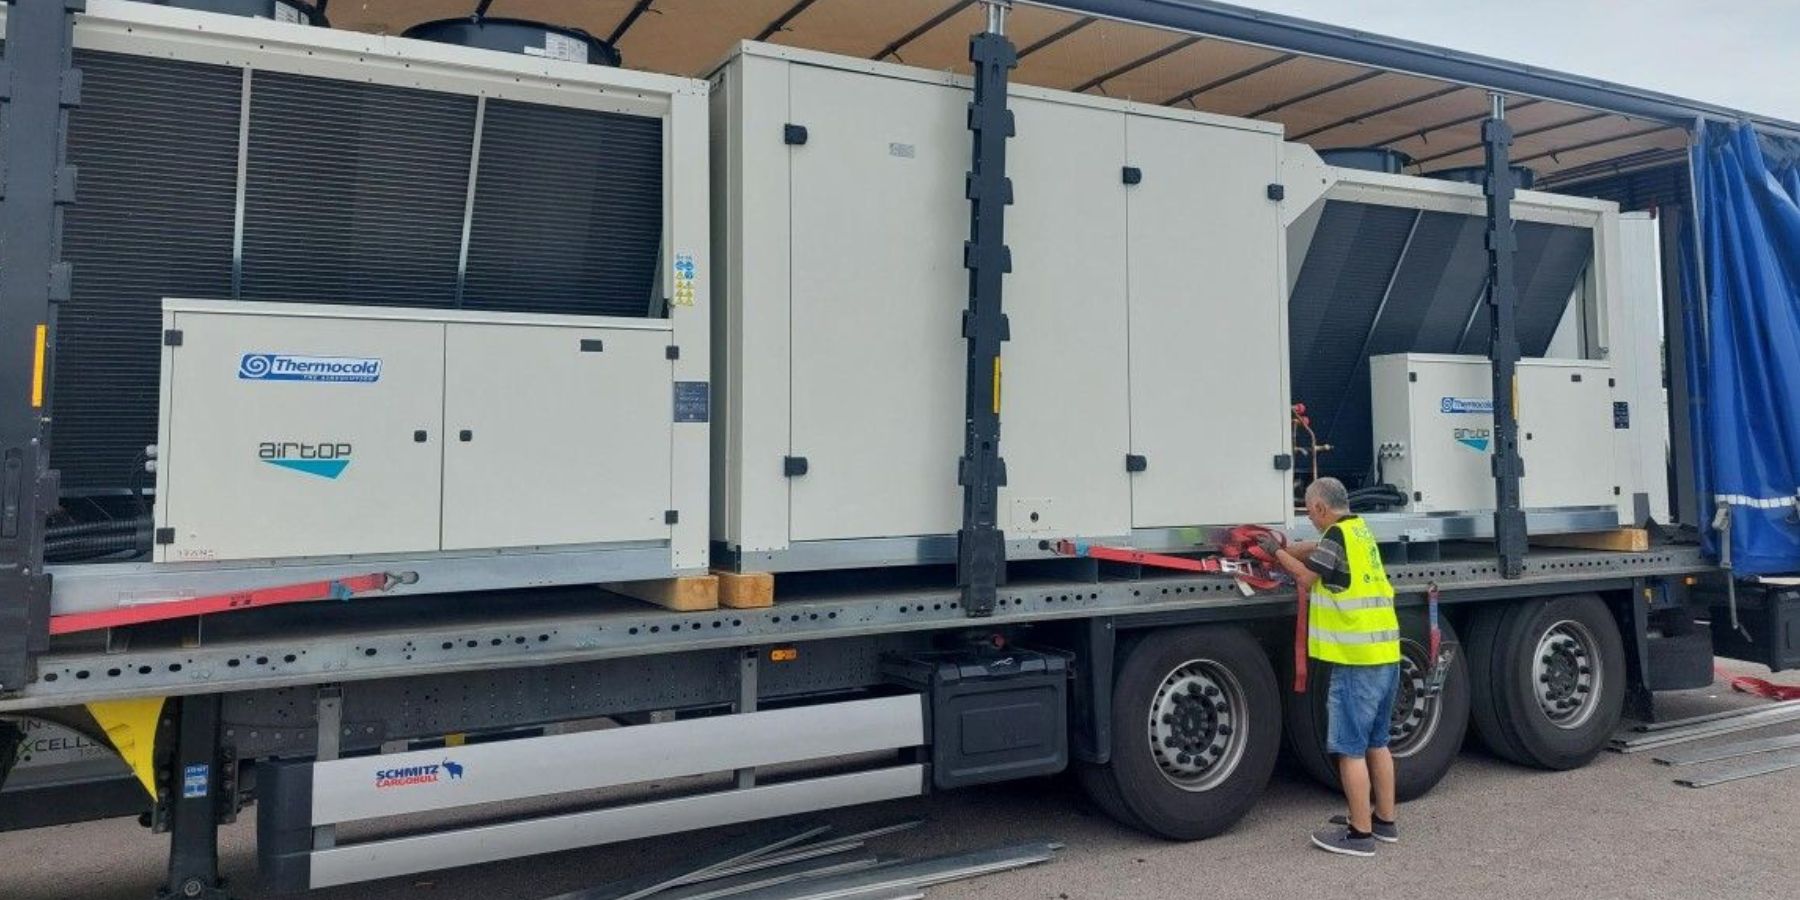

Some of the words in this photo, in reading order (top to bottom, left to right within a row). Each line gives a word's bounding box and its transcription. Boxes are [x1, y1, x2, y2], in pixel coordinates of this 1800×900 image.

[275, 358, 378, 374] Thermocold
[376, 764, 439, 780] SCHMITZ
[376, 775, 439, 788] CARGOBULL
